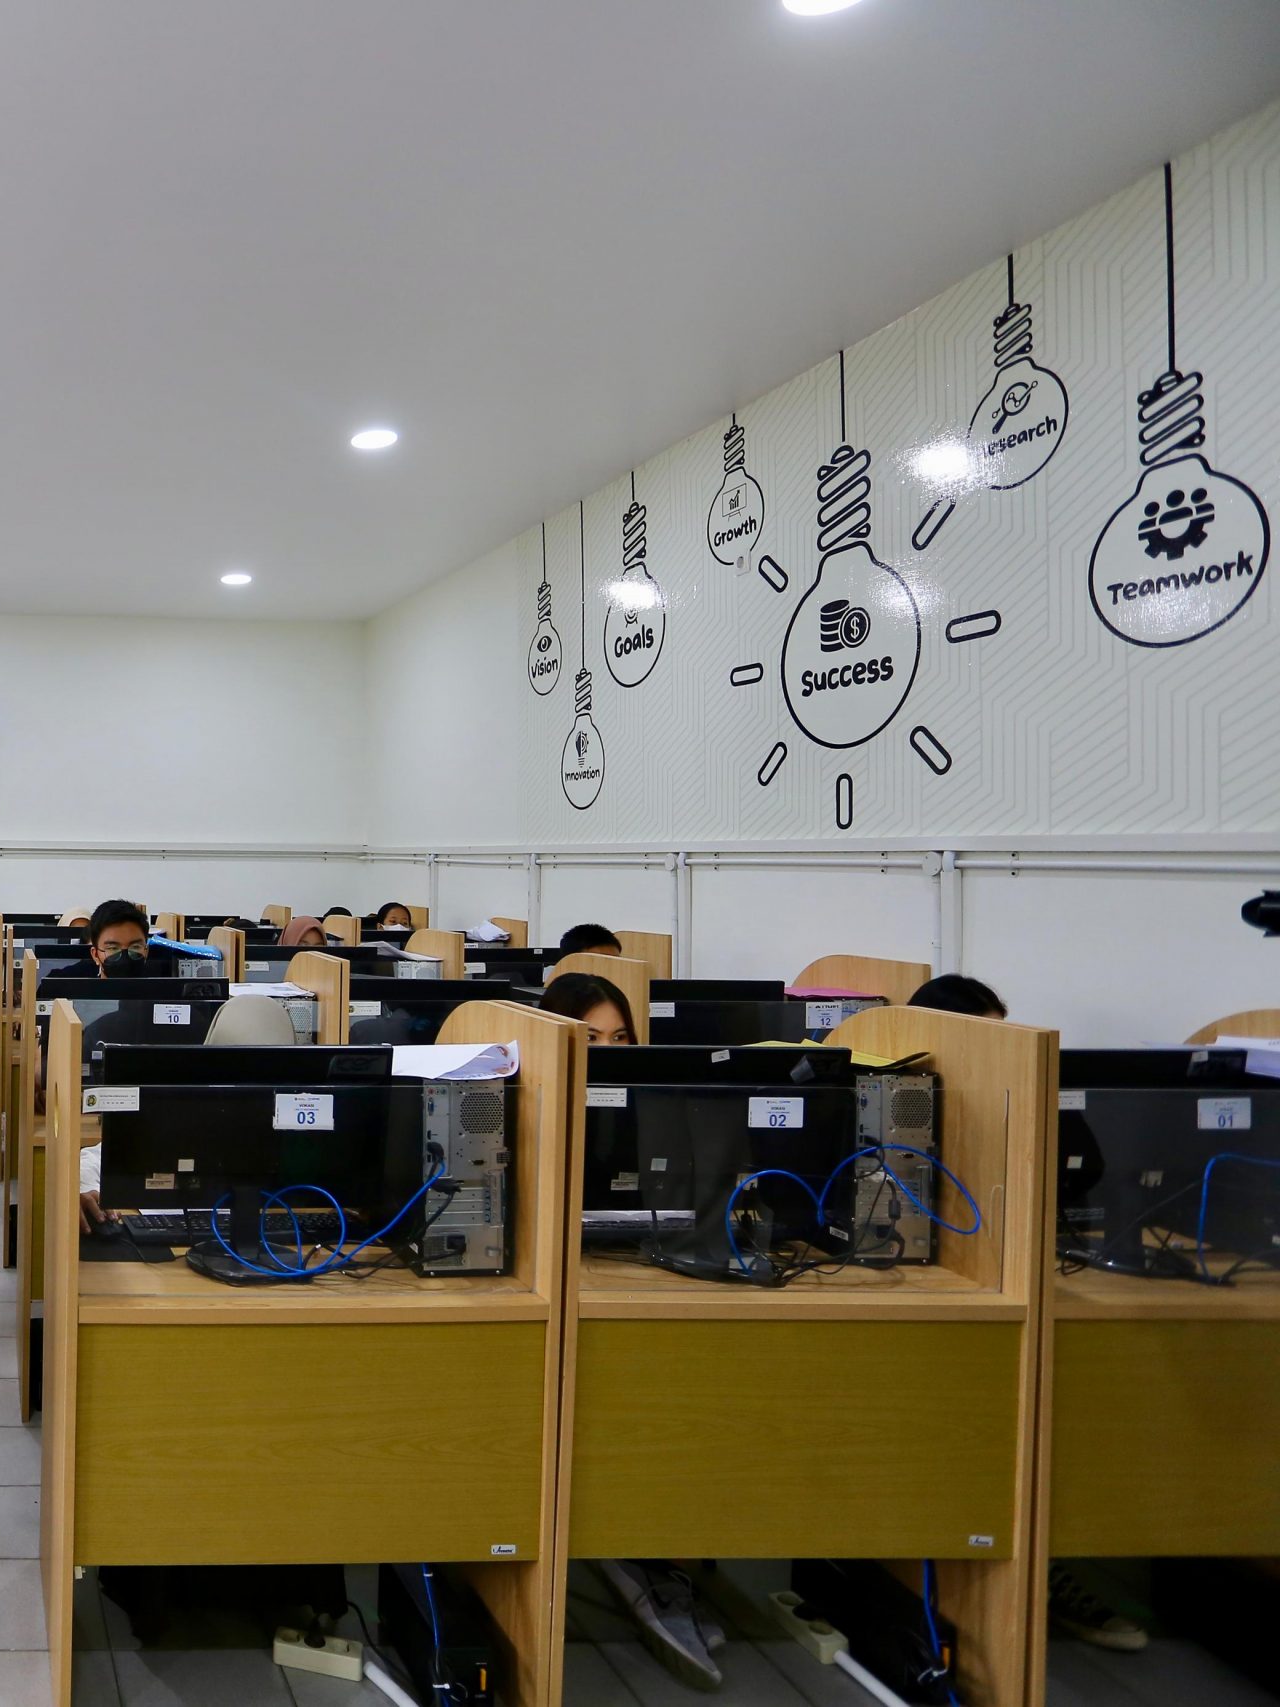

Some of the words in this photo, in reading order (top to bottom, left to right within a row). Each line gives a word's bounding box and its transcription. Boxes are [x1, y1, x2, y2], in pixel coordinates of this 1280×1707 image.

[983, 416, 1057, 457] esearch
[714, 517, 757, 547] Growth
[1107, 551, 1253, 604] Teamwork
[613, 626, 655, 659] Goals
[530, 657, 559, 680] Vision
[801, 655, 894, 698] Success
[564, 765, 601, 783] Innovation
[167, 1014, 180, 1024] 10
[820, 1017, 832, 1027] 12
[296, 1111, 316, 1125] 03
[768, 1114, 788, 1127] 02
[1217, 1113, 1234, 1128] 01
